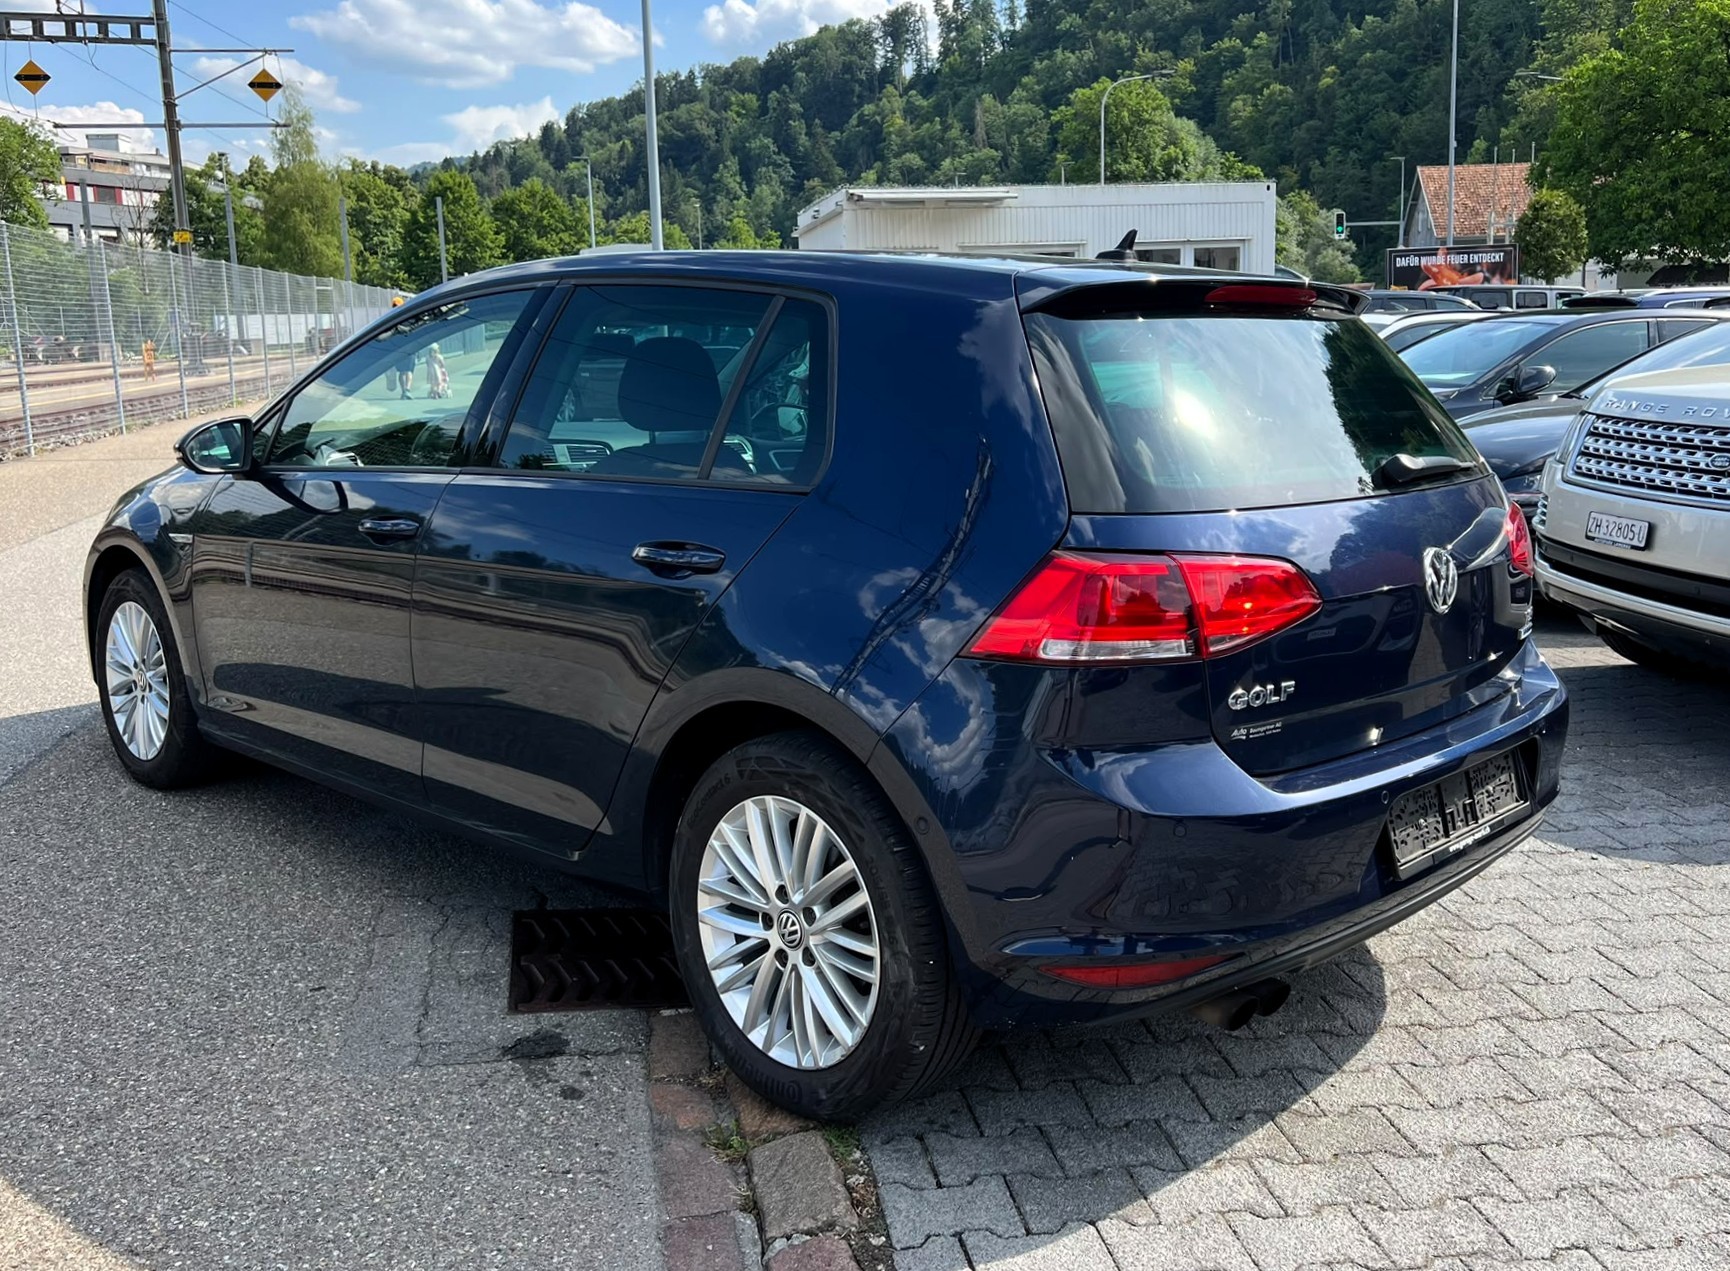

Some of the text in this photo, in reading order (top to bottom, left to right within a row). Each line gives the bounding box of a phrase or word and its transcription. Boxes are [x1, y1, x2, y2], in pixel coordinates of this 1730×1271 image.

[1396, 252, 1504, 267] DAFÜR WURDE FEUER ENTDECKT
[1604, 399, 1670, 414] RANGE
[1228, 680, 1296, 710] GOLF
